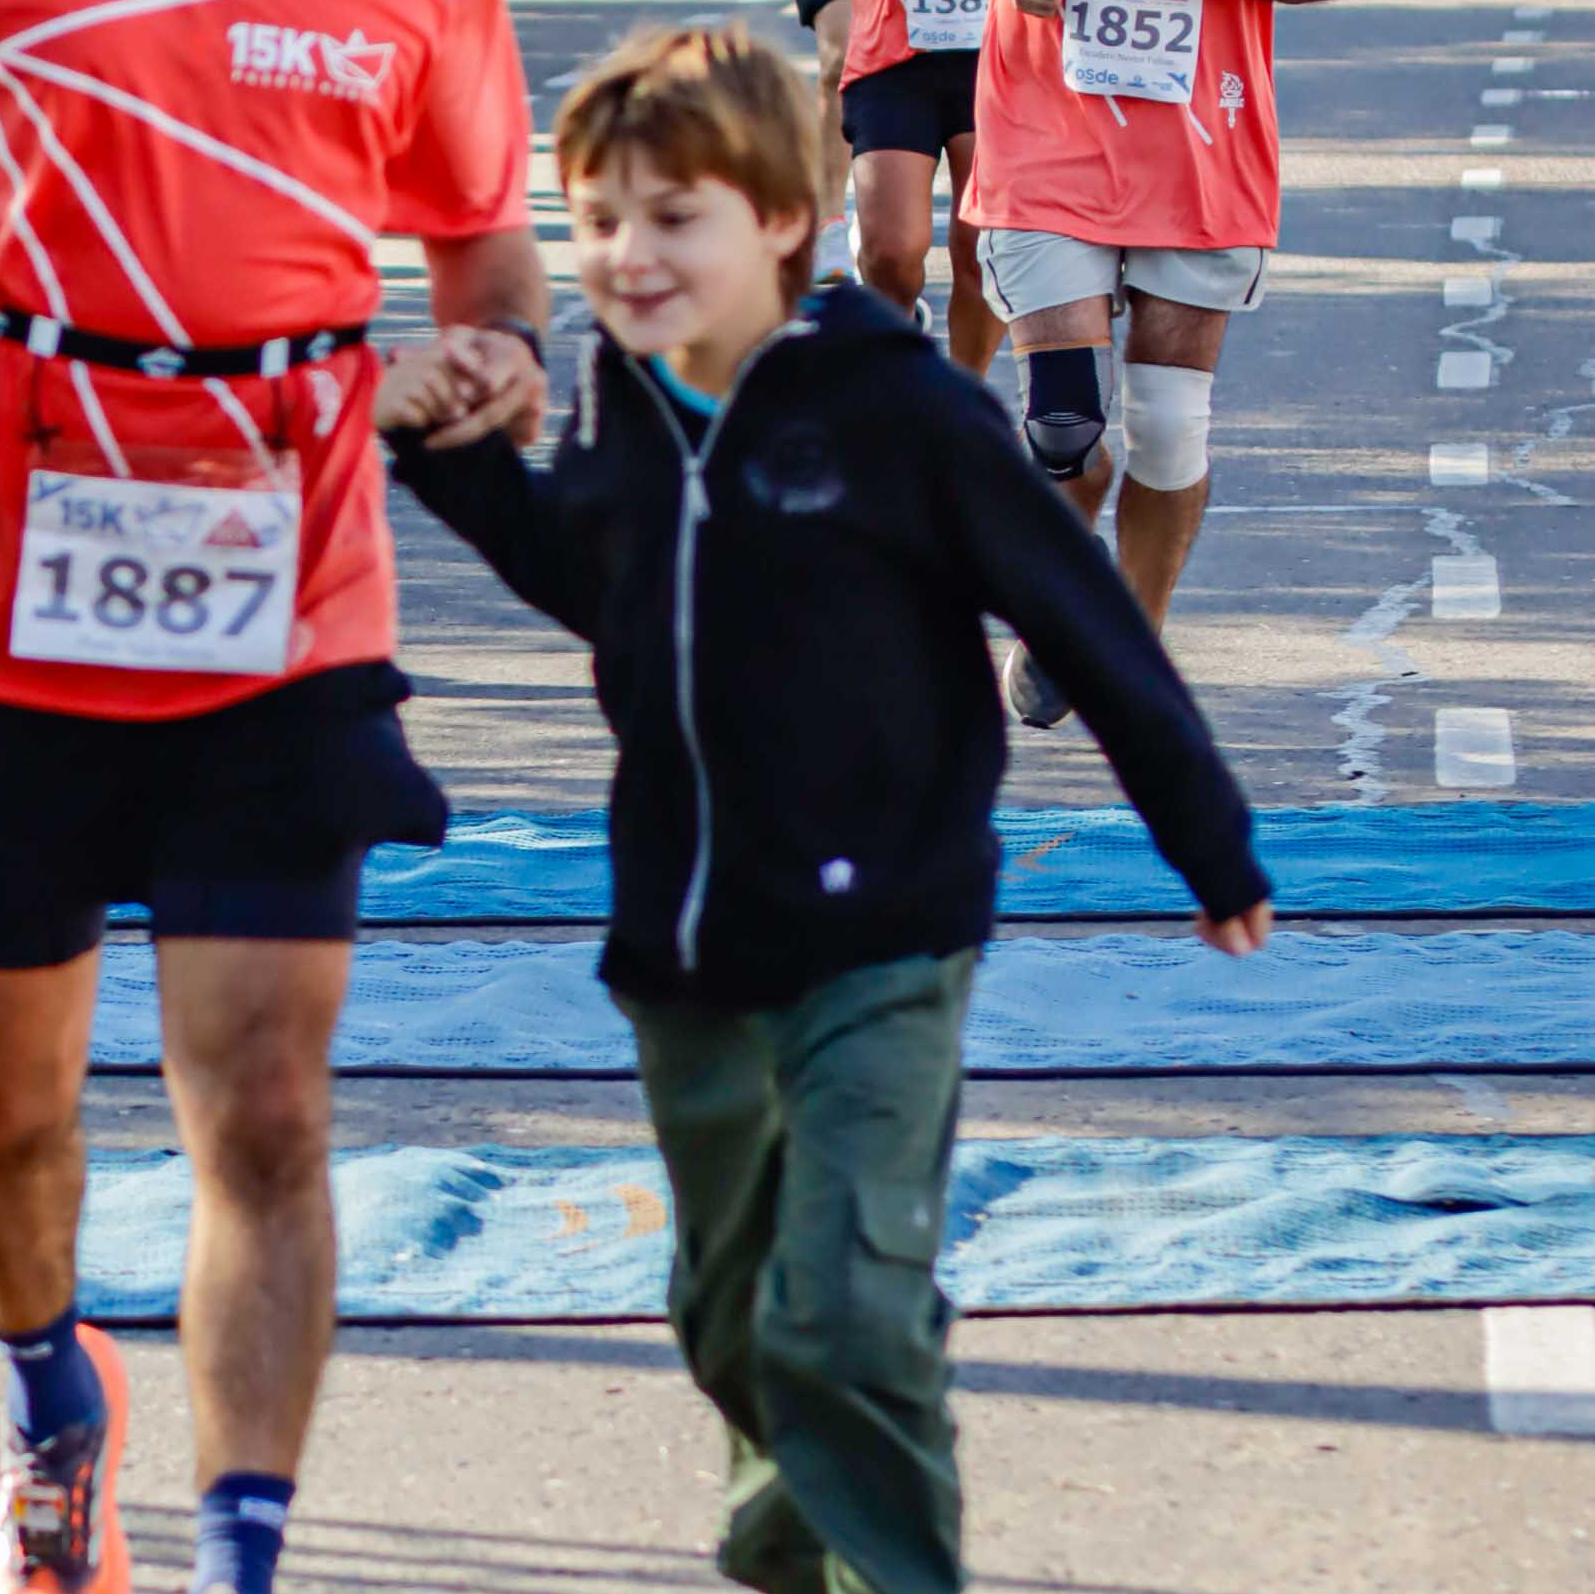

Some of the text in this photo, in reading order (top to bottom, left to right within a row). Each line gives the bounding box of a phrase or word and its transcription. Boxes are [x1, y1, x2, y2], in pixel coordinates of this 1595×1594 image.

[227, 21, 317, 76] 15K
[1069, 1, 1194, 53] 1852
[61, 497, 123, 533] 15K
[32, 552, 276, 637] 1887
